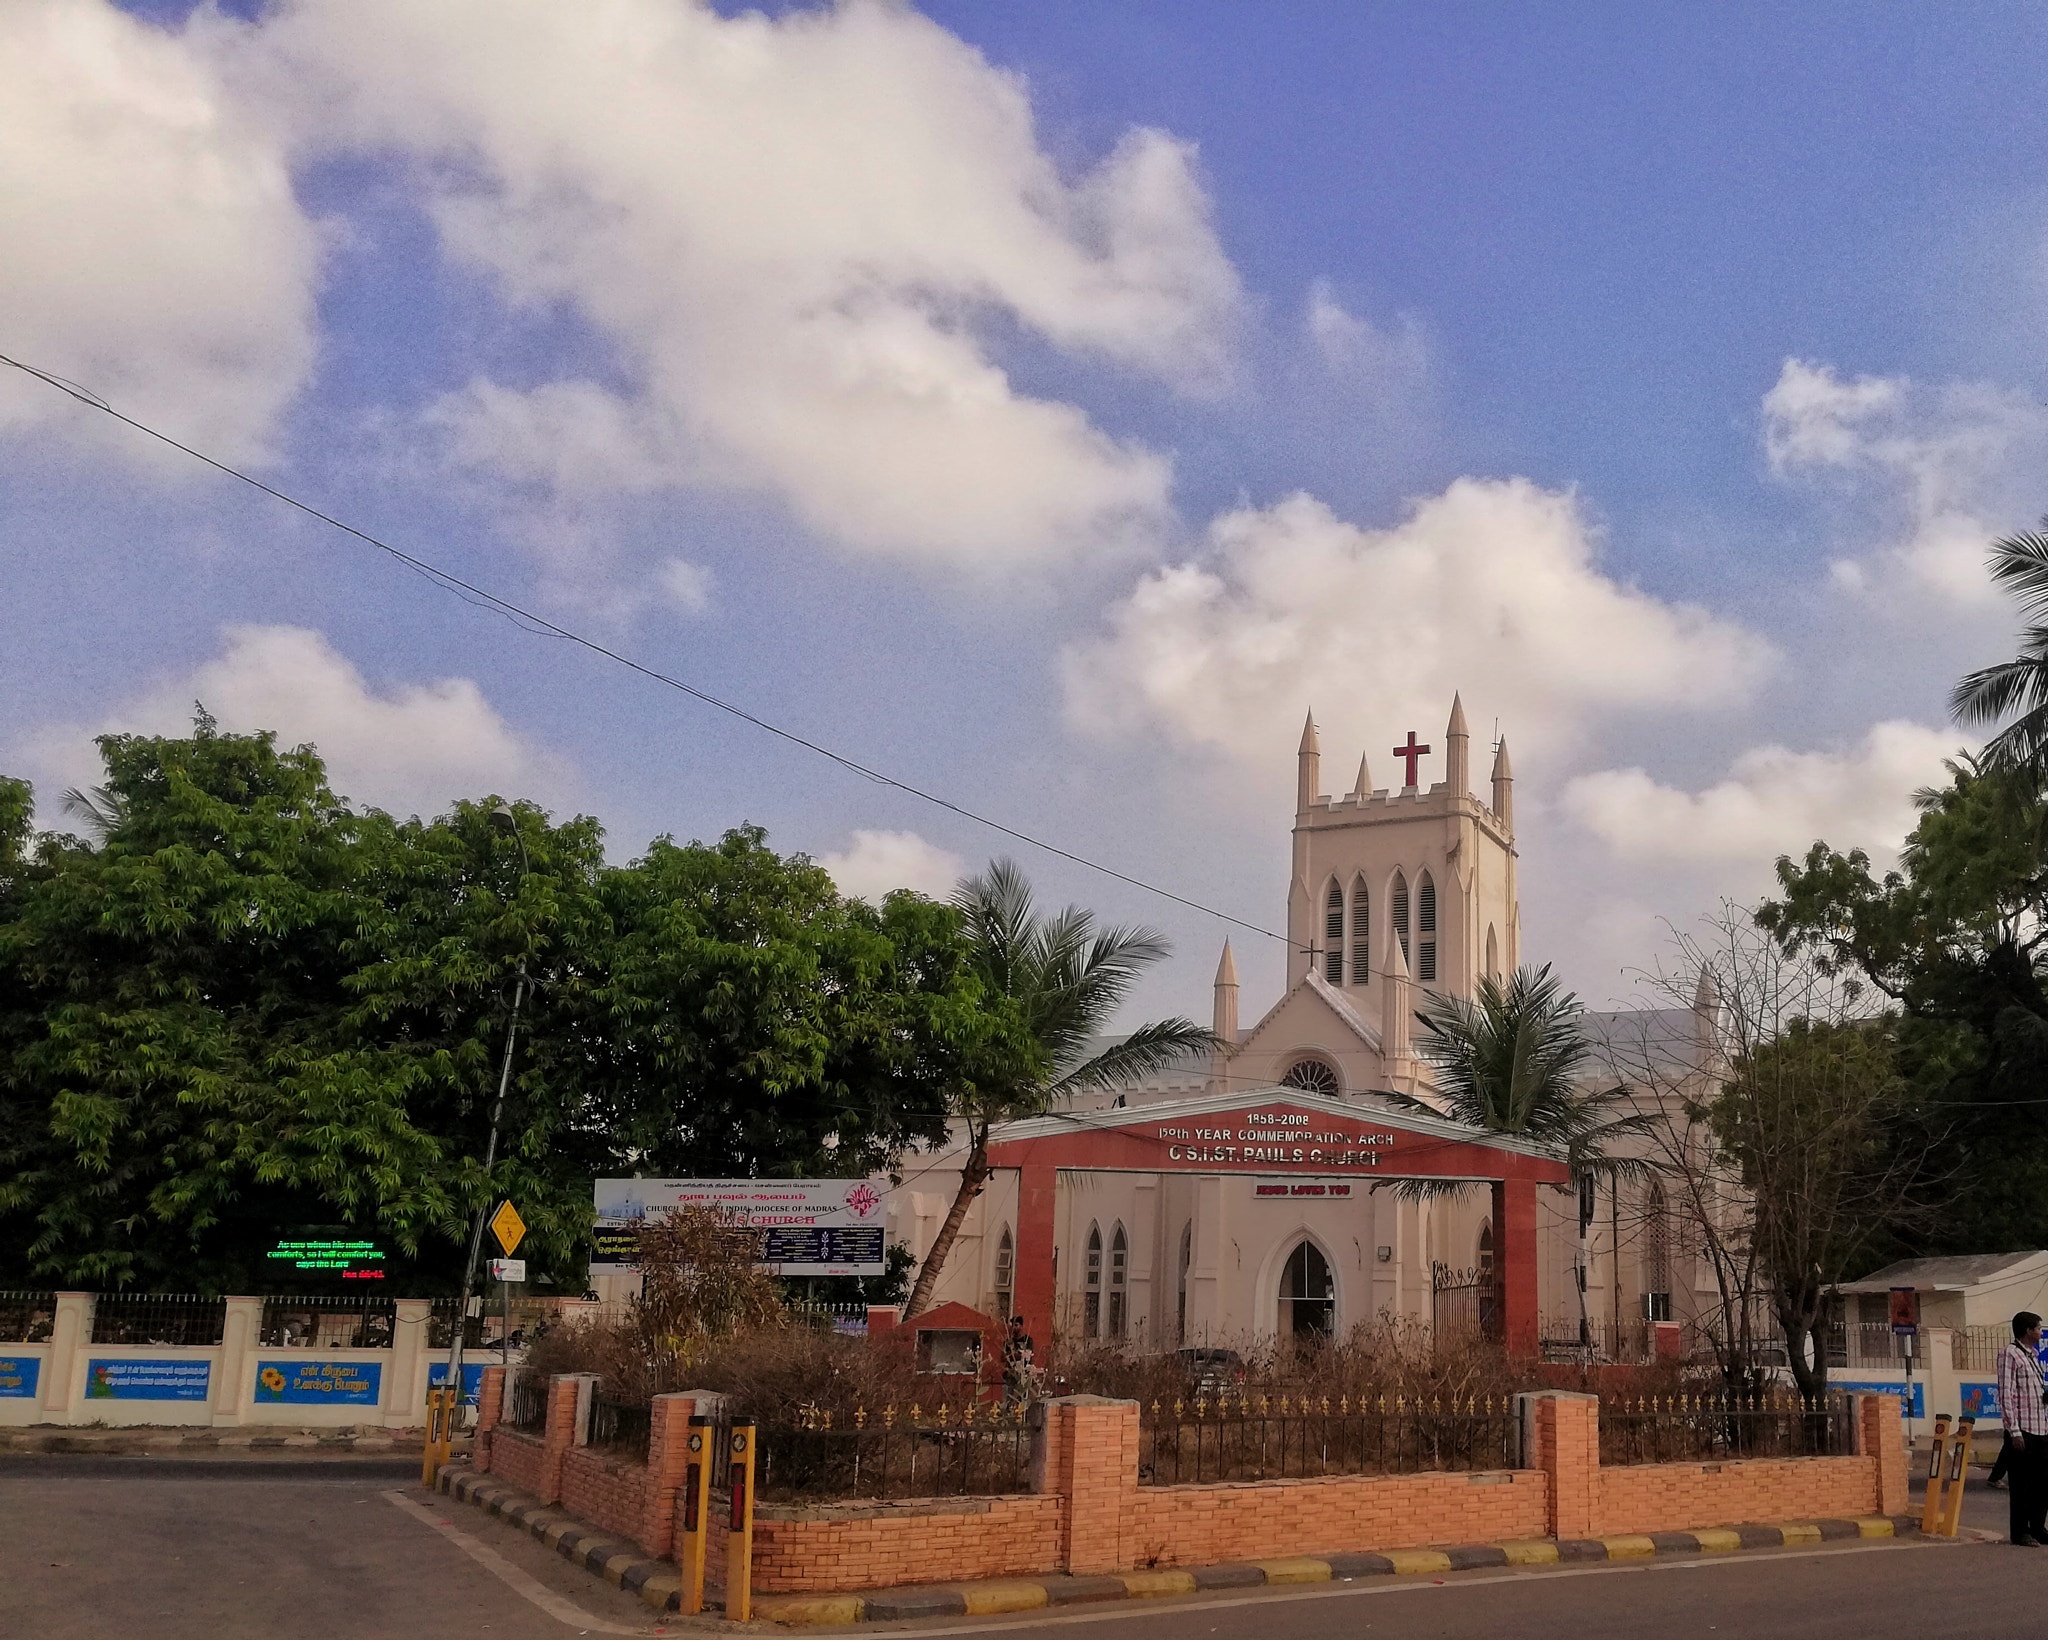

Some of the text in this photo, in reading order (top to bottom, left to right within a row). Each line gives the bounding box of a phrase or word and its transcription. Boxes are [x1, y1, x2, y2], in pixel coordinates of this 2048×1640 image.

[1247, 1113, 1309, 1125] 1858-2008
[1195, 1128, 1232, 1140] YEAR
[1238, 1129, 1352, 1144] COMMEMORATION
[1358, 1134, 1394, 1145] ARCH
[1310, 1149, 1383, 1166] CHURCH
[1256, 1185, 1351, 1196] JESUS LOVES YOU
[750, 1215, 816, 1225] CHURCH
[267, 1251, 305, 1259] comforts,
[368, 1252, 385, 1260] you,
[316, 1260, 330, 1268] the
[330, 1260, 350, 1268] Lord
